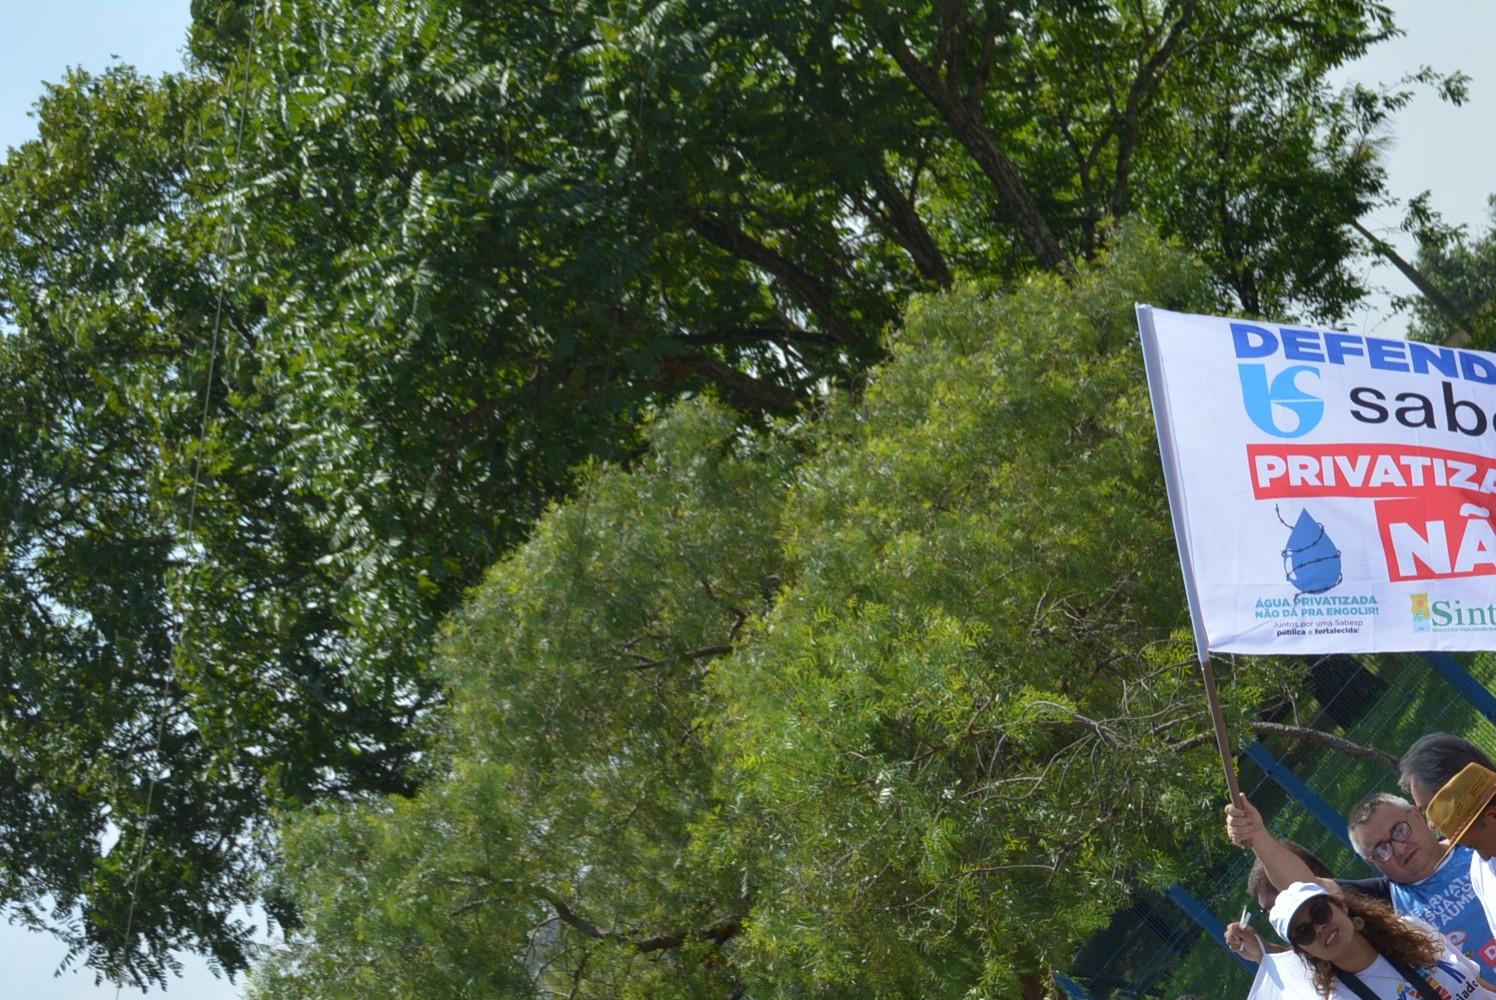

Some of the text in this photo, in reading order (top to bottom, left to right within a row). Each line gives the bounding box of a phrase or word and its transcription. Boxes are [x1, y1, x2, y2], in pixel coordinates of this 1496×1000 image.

[1255, 596, 1378, 609] ÁGUA PRIVATIZADA
[1255, 607, 1380, 619] NÃO DÁ PRA ENGOLIR!
[1335, 619, 1364, 628] Sabesp
[1276, 627, 1306, 637] pública
